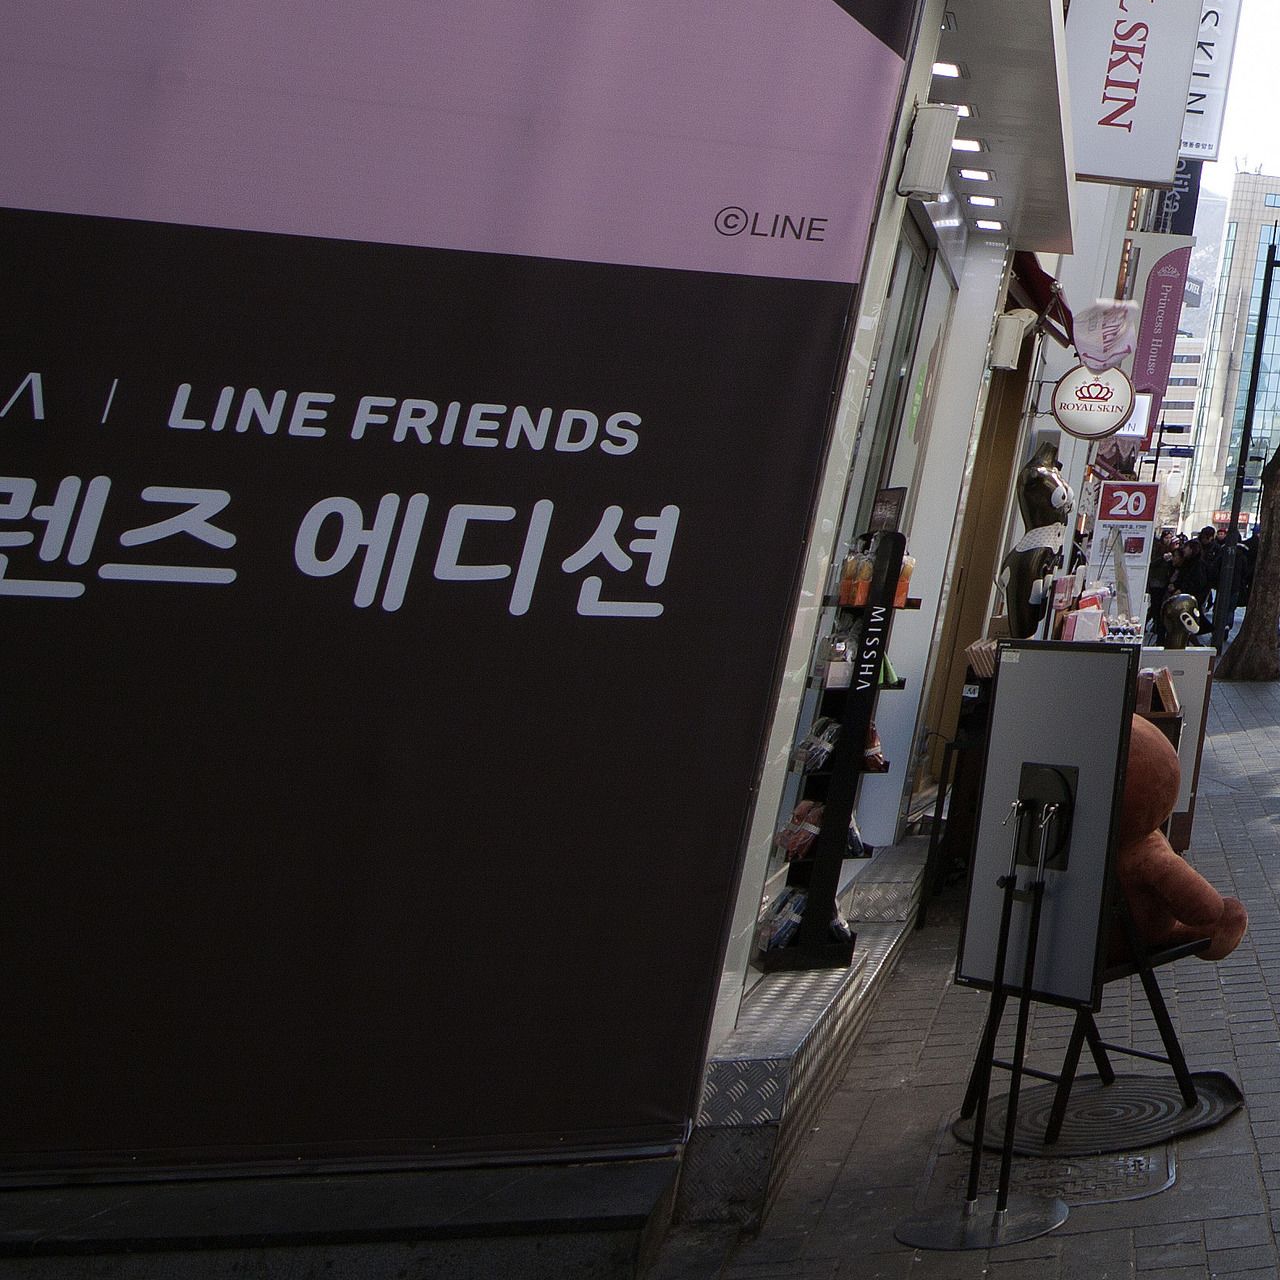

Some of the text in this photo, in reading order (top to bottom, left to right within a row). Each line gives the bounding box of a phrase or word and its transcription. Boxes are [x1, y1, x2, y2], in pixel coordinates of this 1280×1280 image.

[1098, 18, 1150, 133] SKIN
[1164, 159, 1192, 213] olika
[1146, 283, 1173, 376] Princess House
[169, 383, 642, 456] LINE FRIENDS
[1059, 402, 1124, 413] ROYAL SKIN
[1109, 490, 1147, 516] 20
[293, 492, 682, 618] 에디션
[856, 606, 887, 691] MISSHA
